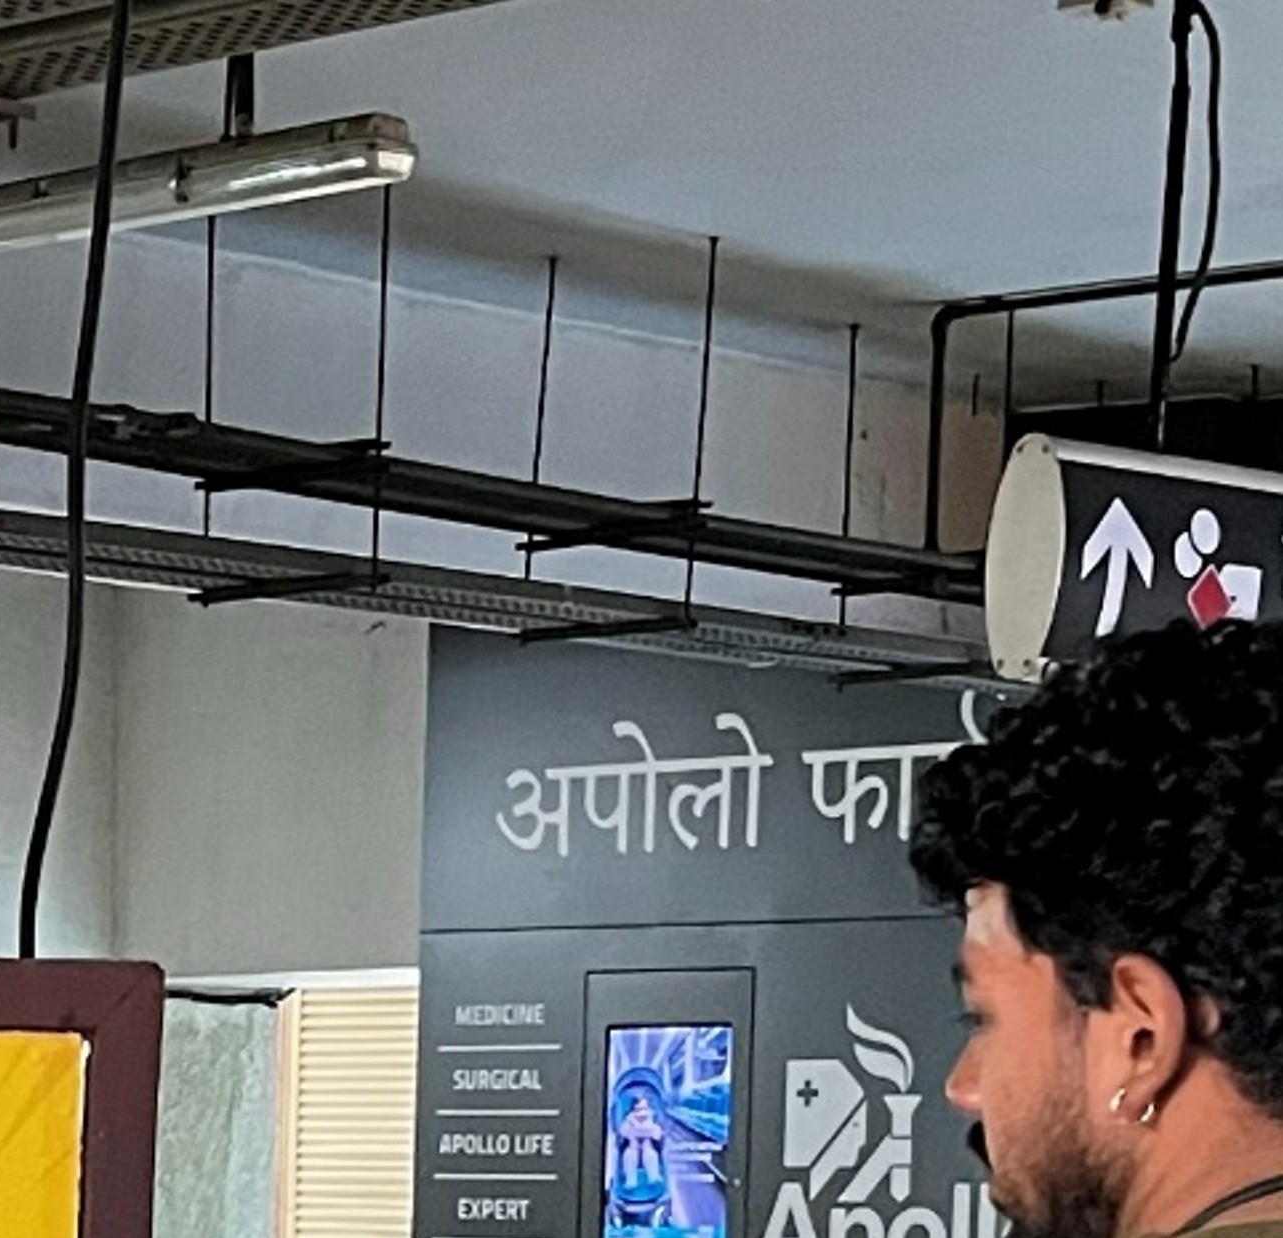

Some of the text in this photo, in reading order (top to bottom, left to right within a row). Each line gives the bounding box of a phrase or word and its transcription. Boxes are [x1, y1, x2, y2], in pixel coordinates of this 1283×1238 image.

[495, 712, 774, 857] अपोलो
[455, 1003, 545, 1026] MEDICINE
[452, 1069, 542, 1091] SURGICAL
[439, 1133, 554, 1155] APOLLO LIFE
[457, 1197, 530, 1220] EXPERT
